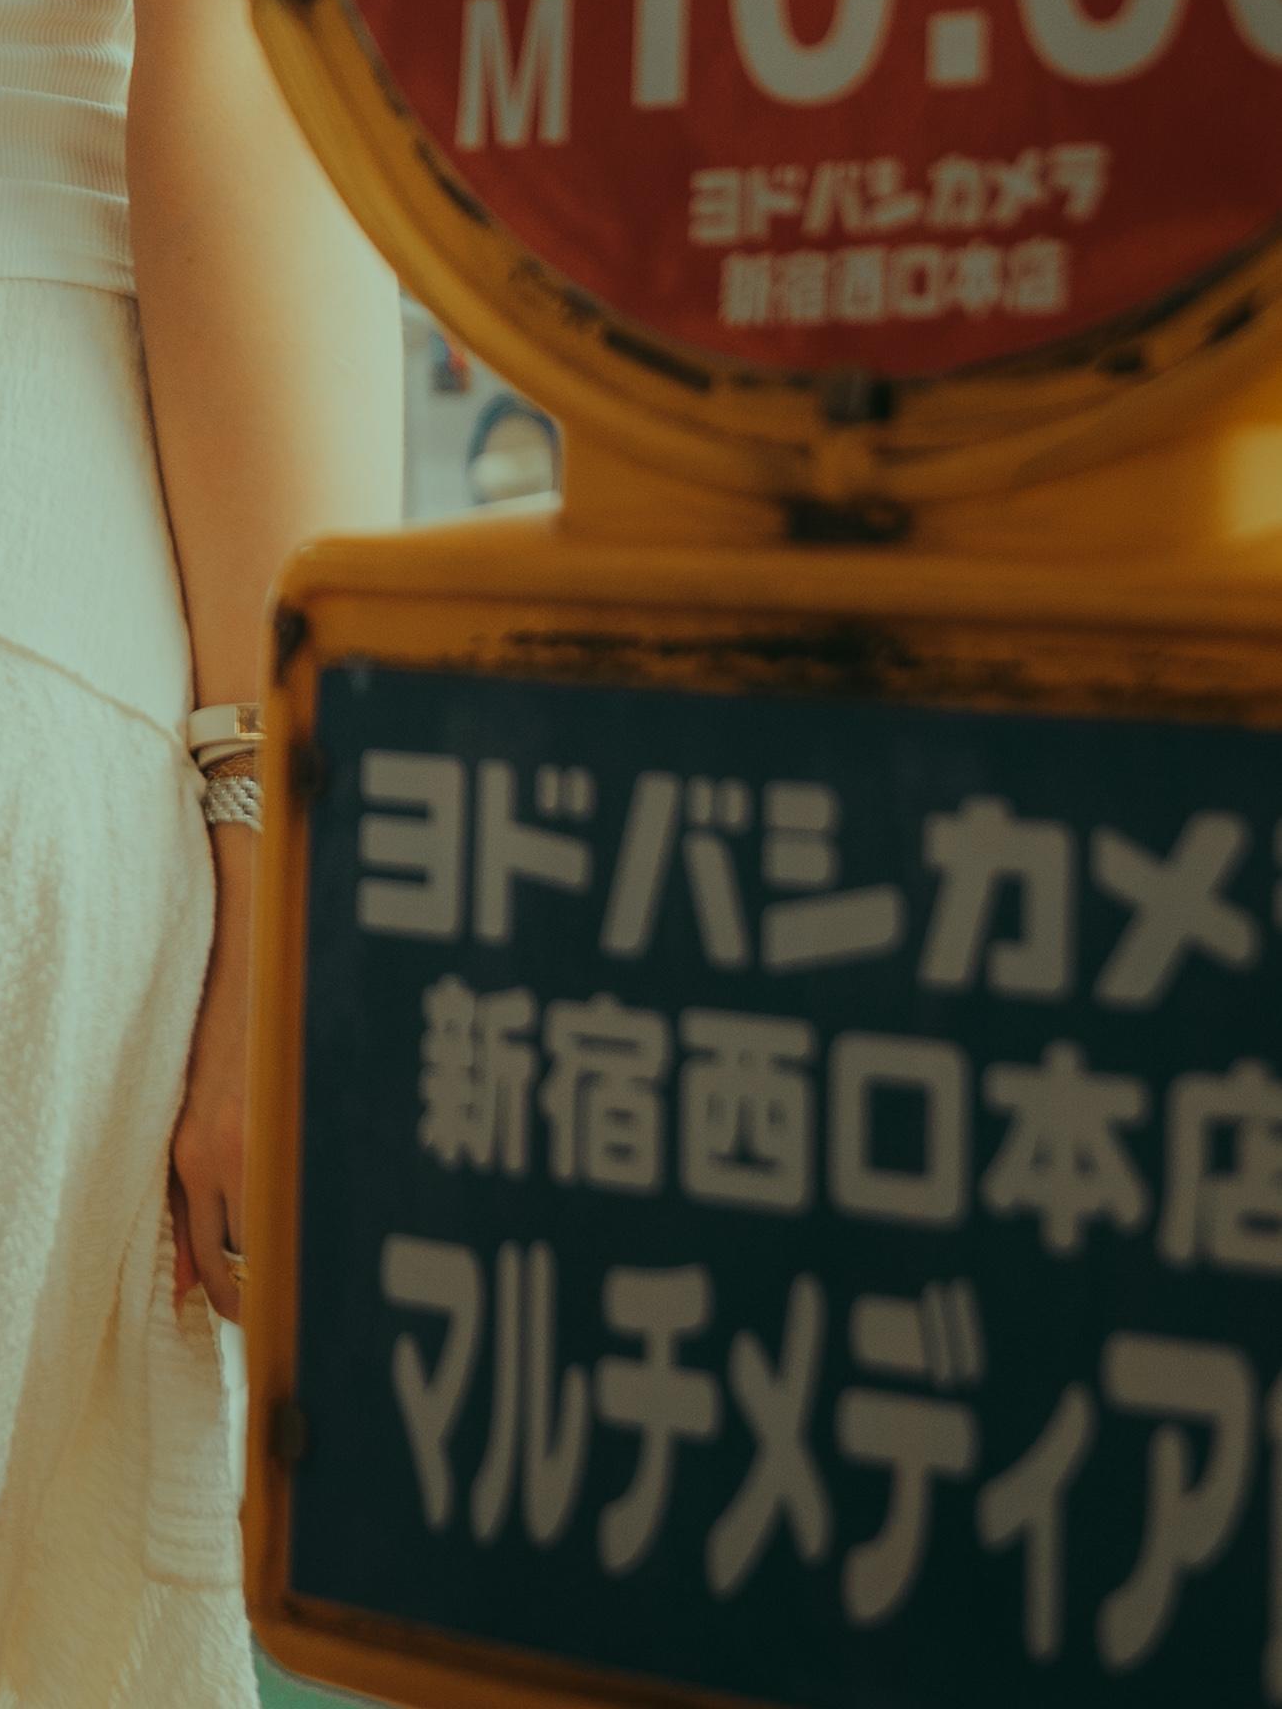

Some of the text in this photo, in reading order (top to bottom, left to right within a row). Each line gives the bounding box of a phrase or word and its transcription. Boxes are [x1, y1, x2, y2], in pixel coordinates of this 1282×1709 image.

[688, 142, 1112, 246] ヨドバシカメラ
[359, 750, 1282, 1011] ヨドバシカメ
[380, 1236, 1282, 1673] マルチメディア
